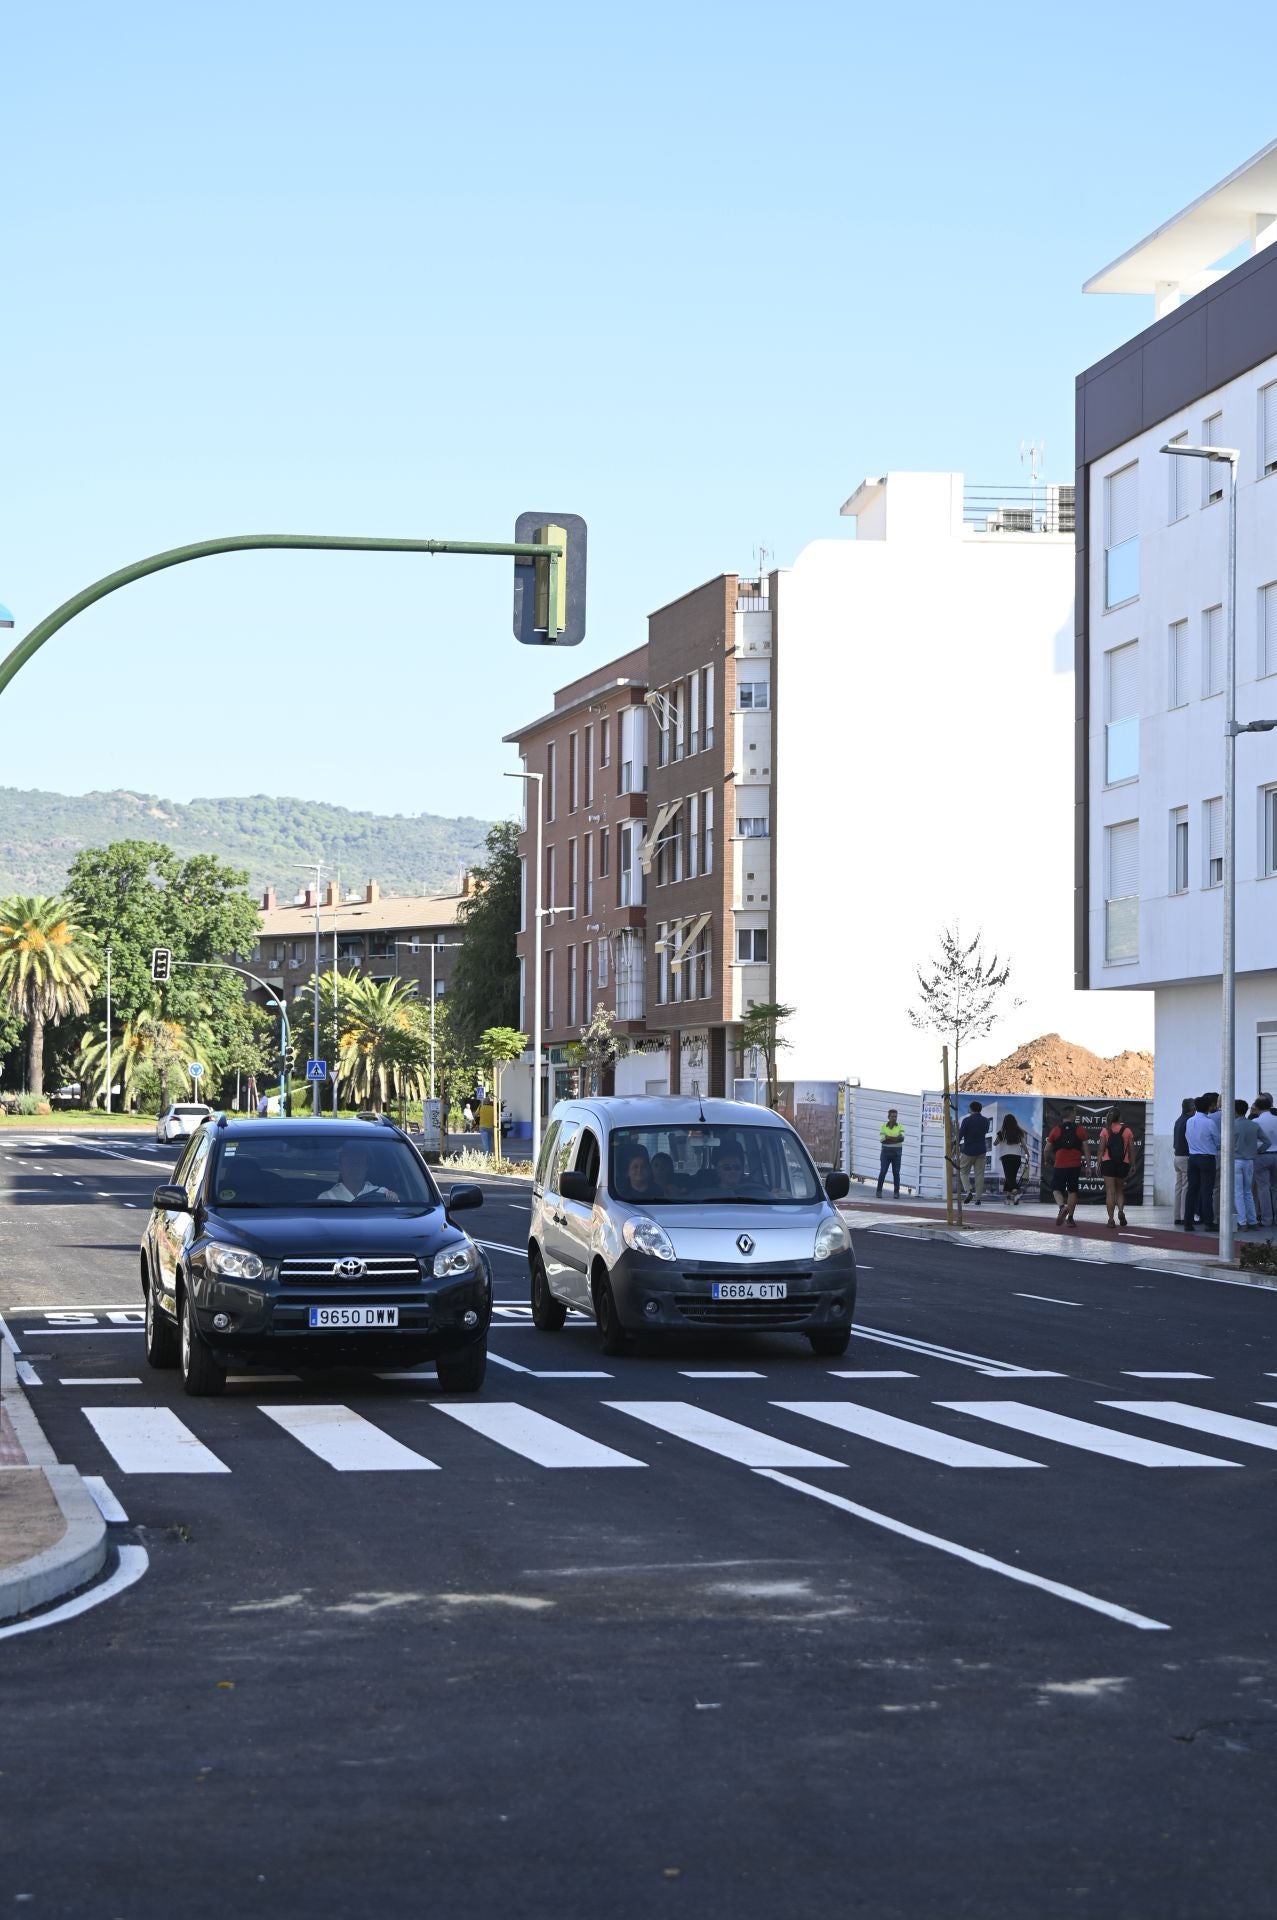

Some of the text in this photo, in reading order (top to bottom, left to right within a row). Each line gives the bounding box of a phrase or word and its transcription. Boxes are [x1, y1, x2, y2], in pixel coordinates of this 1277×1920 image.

[721, 1285, 784, 1297] 6684 GTN
[320, 1309, 395, 1324] 9650 DWW
